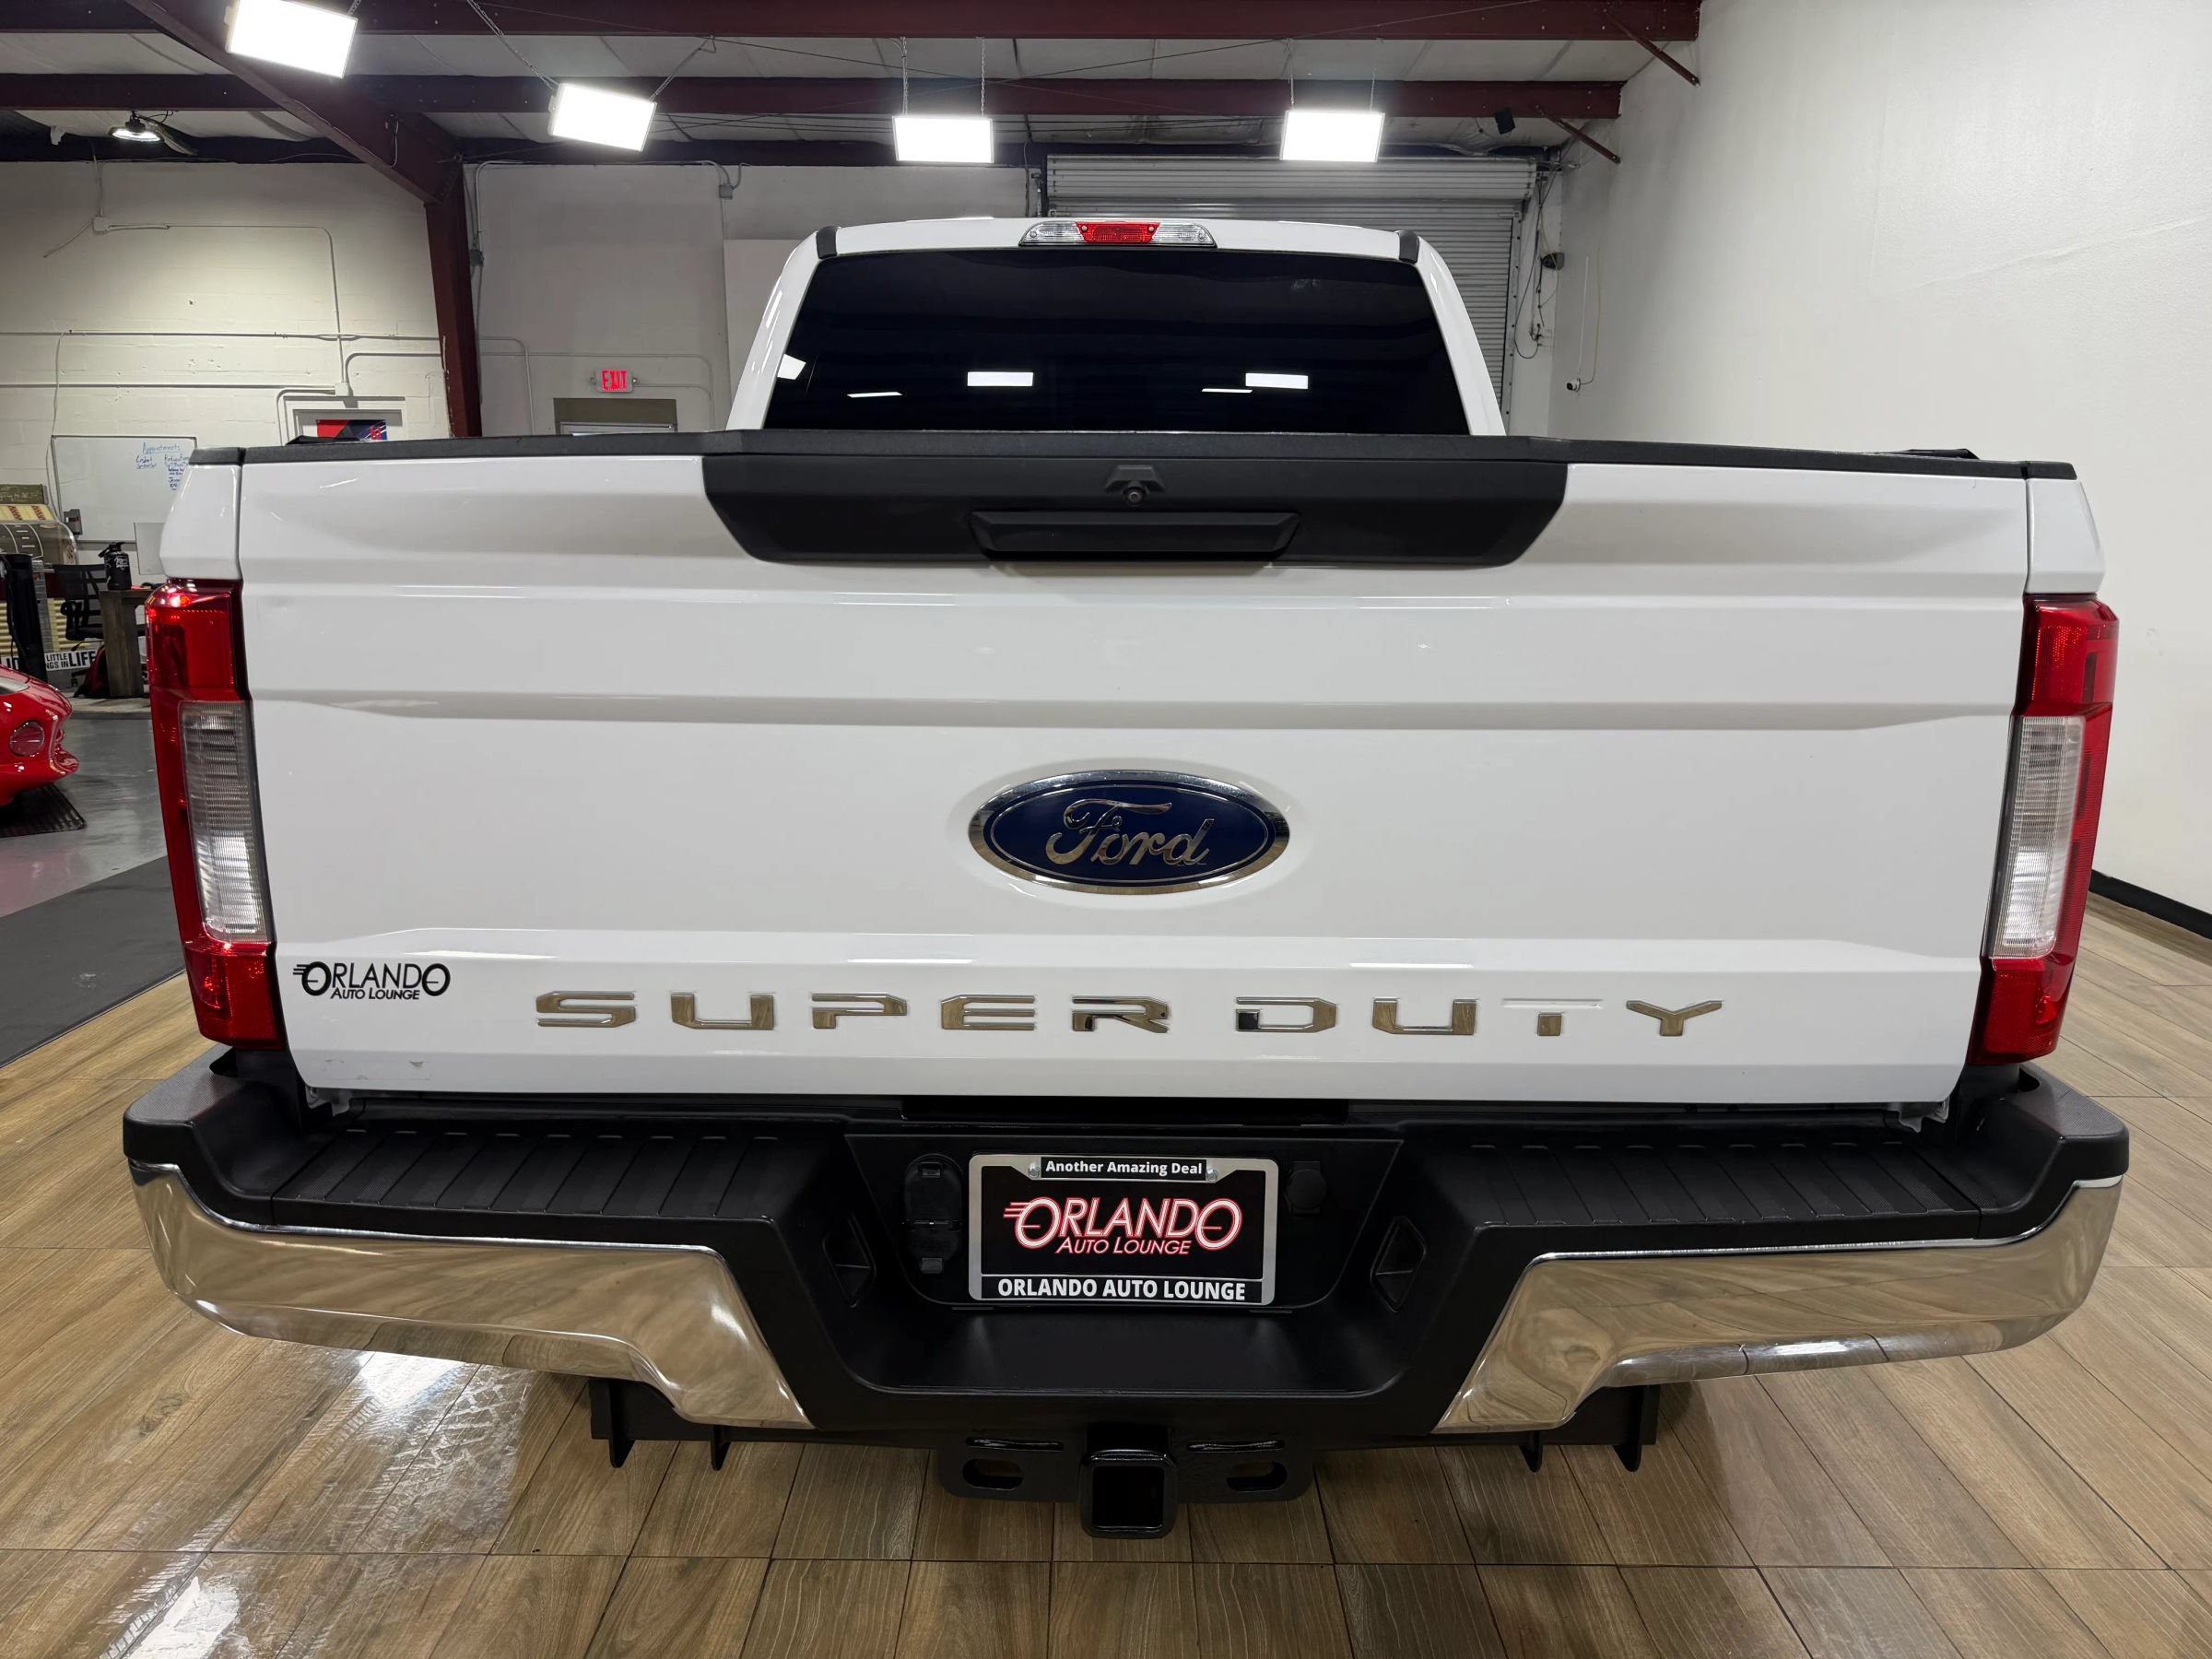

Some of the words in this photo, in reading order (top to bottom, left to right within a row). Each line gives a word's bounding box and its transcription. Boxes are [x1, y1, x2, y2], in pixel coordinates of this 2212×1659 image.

[602, 370, 628, 392] EXIT
[46, 653, 67, 661] LITTLE
[1045, 798, 1216, 865] Ford
[293, 961, 451, 996] ORLANDO
[330, 987, 365, 1000] AUTO
[369, 987, 420, 1000] LOUNGE
[535, 991, 1170, 1034] SUPER
[1235, 996, 1724, 1037] DUTY
[1045, 1159, 1104, 1173] Another
[1107, 1161, 1168, 1176] Amazing
[1171, 1162, 1203, 1174] Deal
[1003, 1196, 1242, 1251] ORLANDO
[1055, 1236, 1110, 1254] AUTO
[1112, 1237, 1192, 1255] LOUNGE
[998, 1278, 1097, 1297] ORLANDO
[1102, 1279, 1158, 1299] AUTO
[1163, 1281, 1245, 1300] LOUNGE
